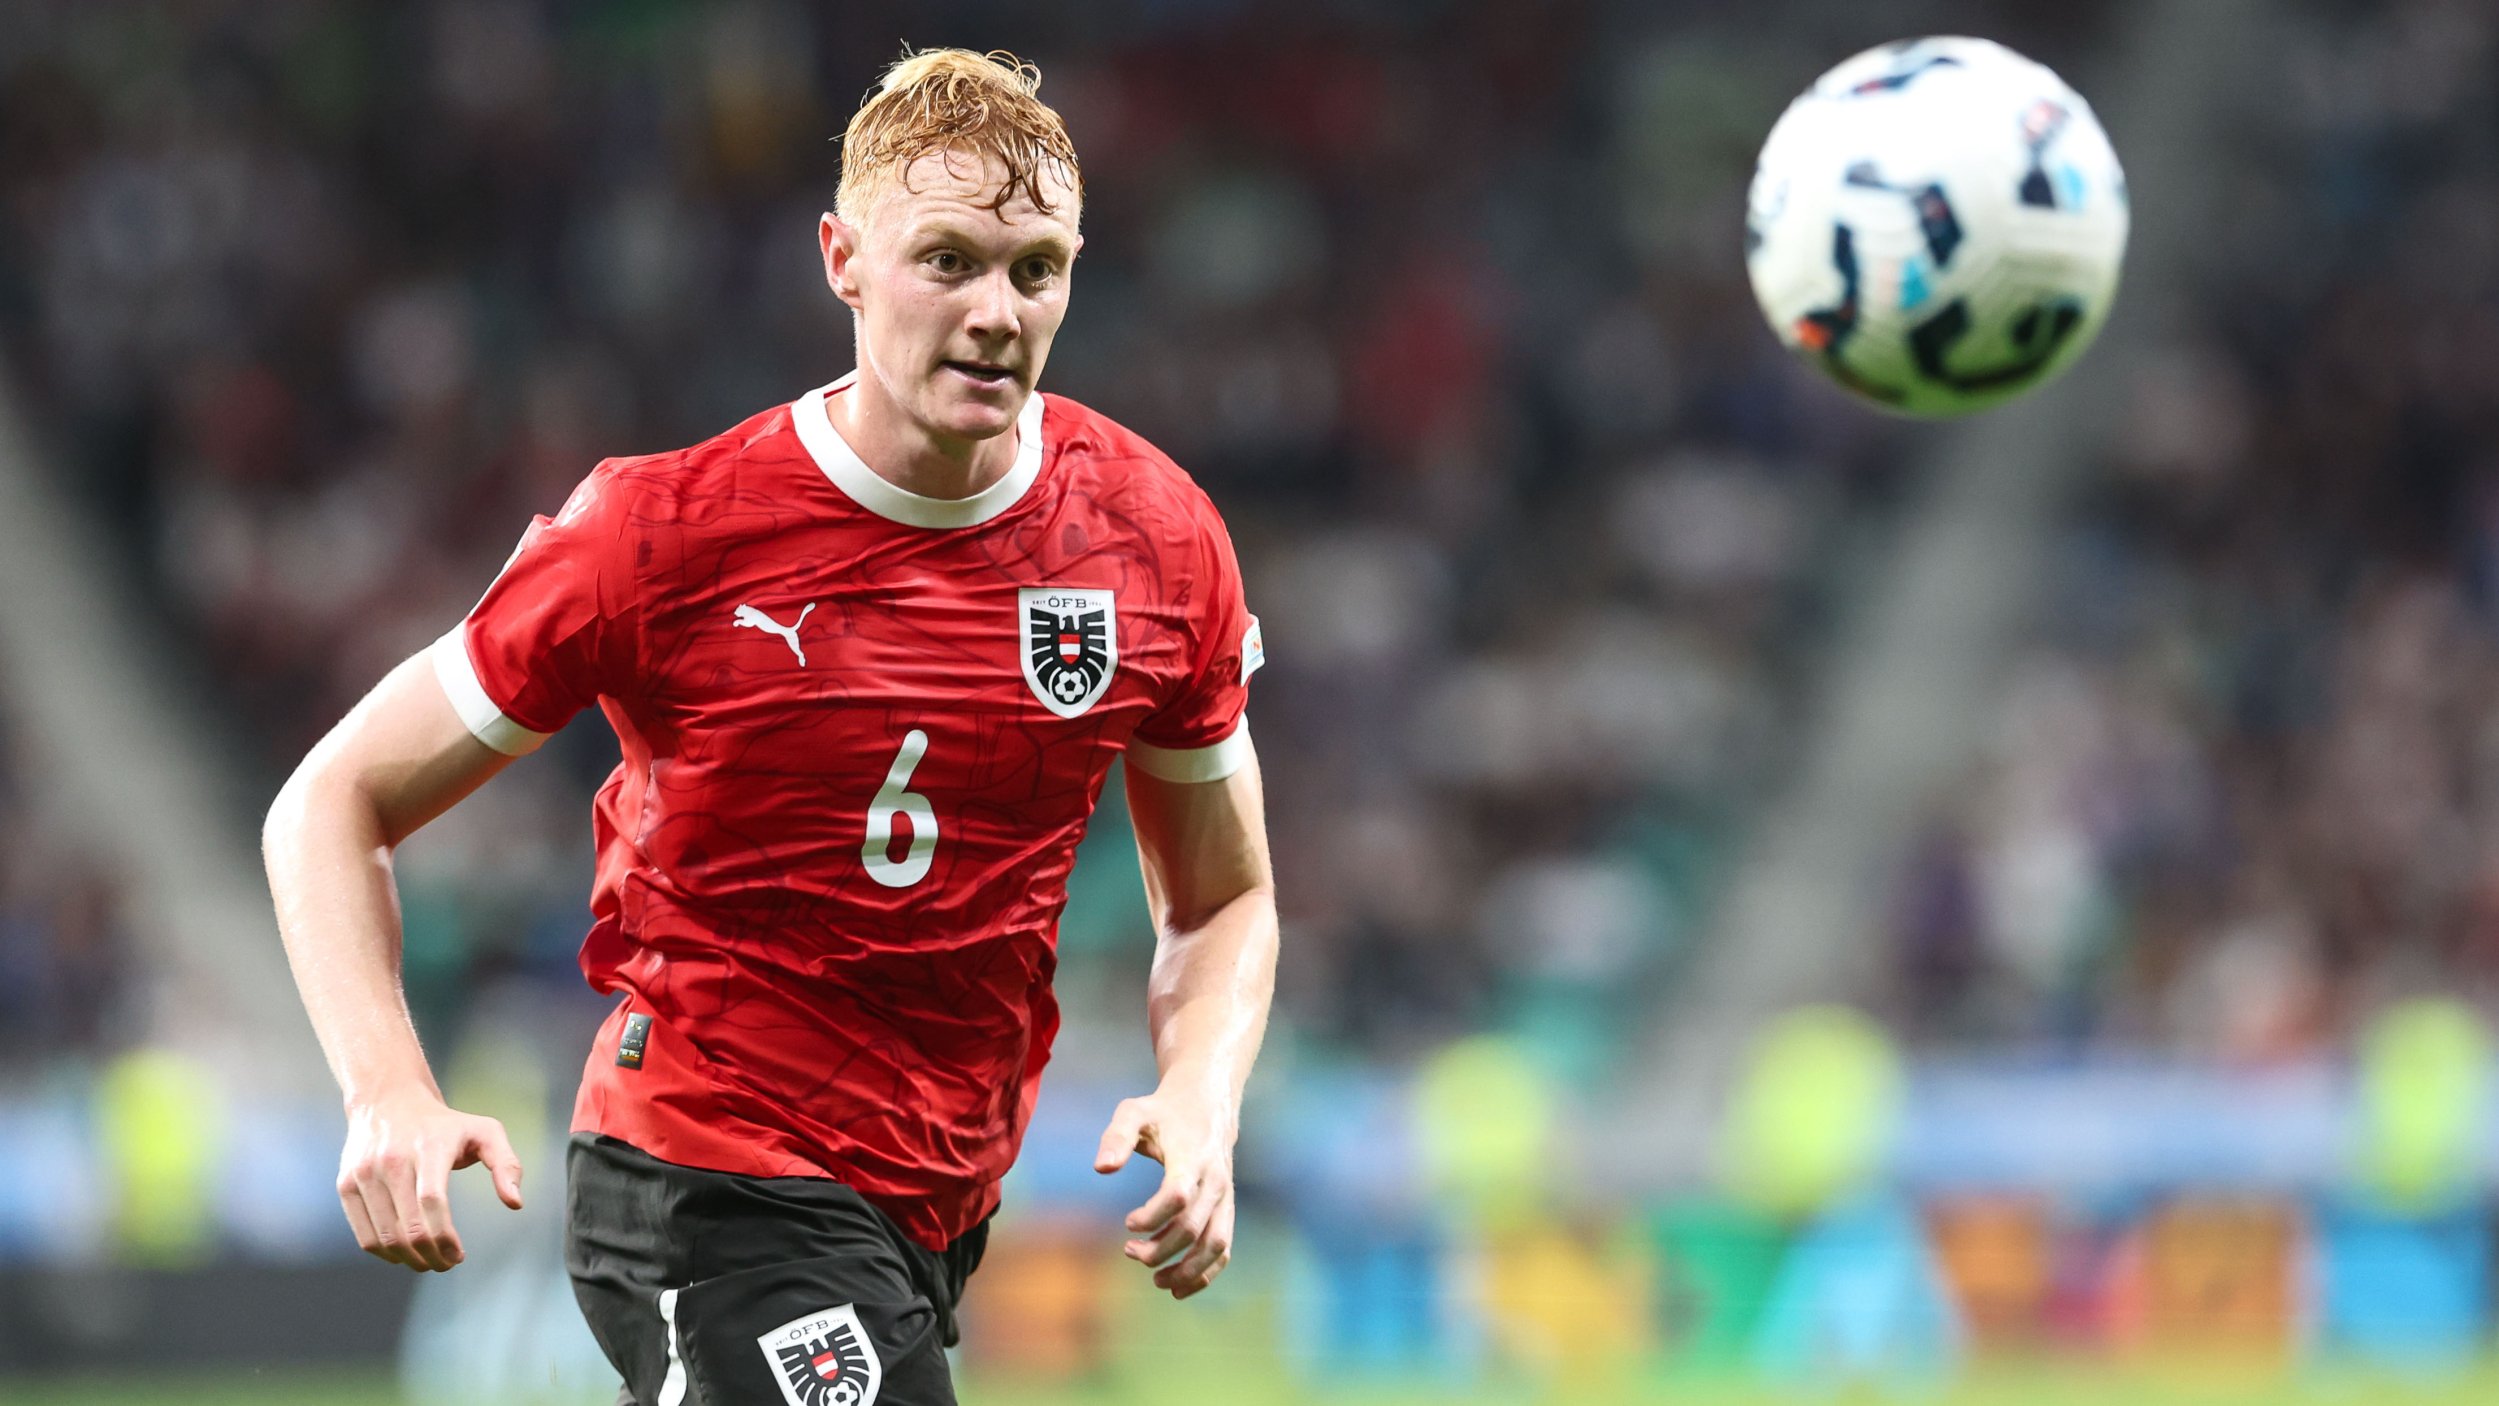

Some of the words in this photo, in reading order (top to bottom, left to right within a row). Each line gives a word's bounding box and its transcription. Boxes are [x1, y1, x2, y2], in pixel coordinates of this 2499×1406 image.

[1048, 595, 1087, 608] ÖFB
[862, 729, 939, 888] 6
[789, 1319, 829, 1340] ÖFB
